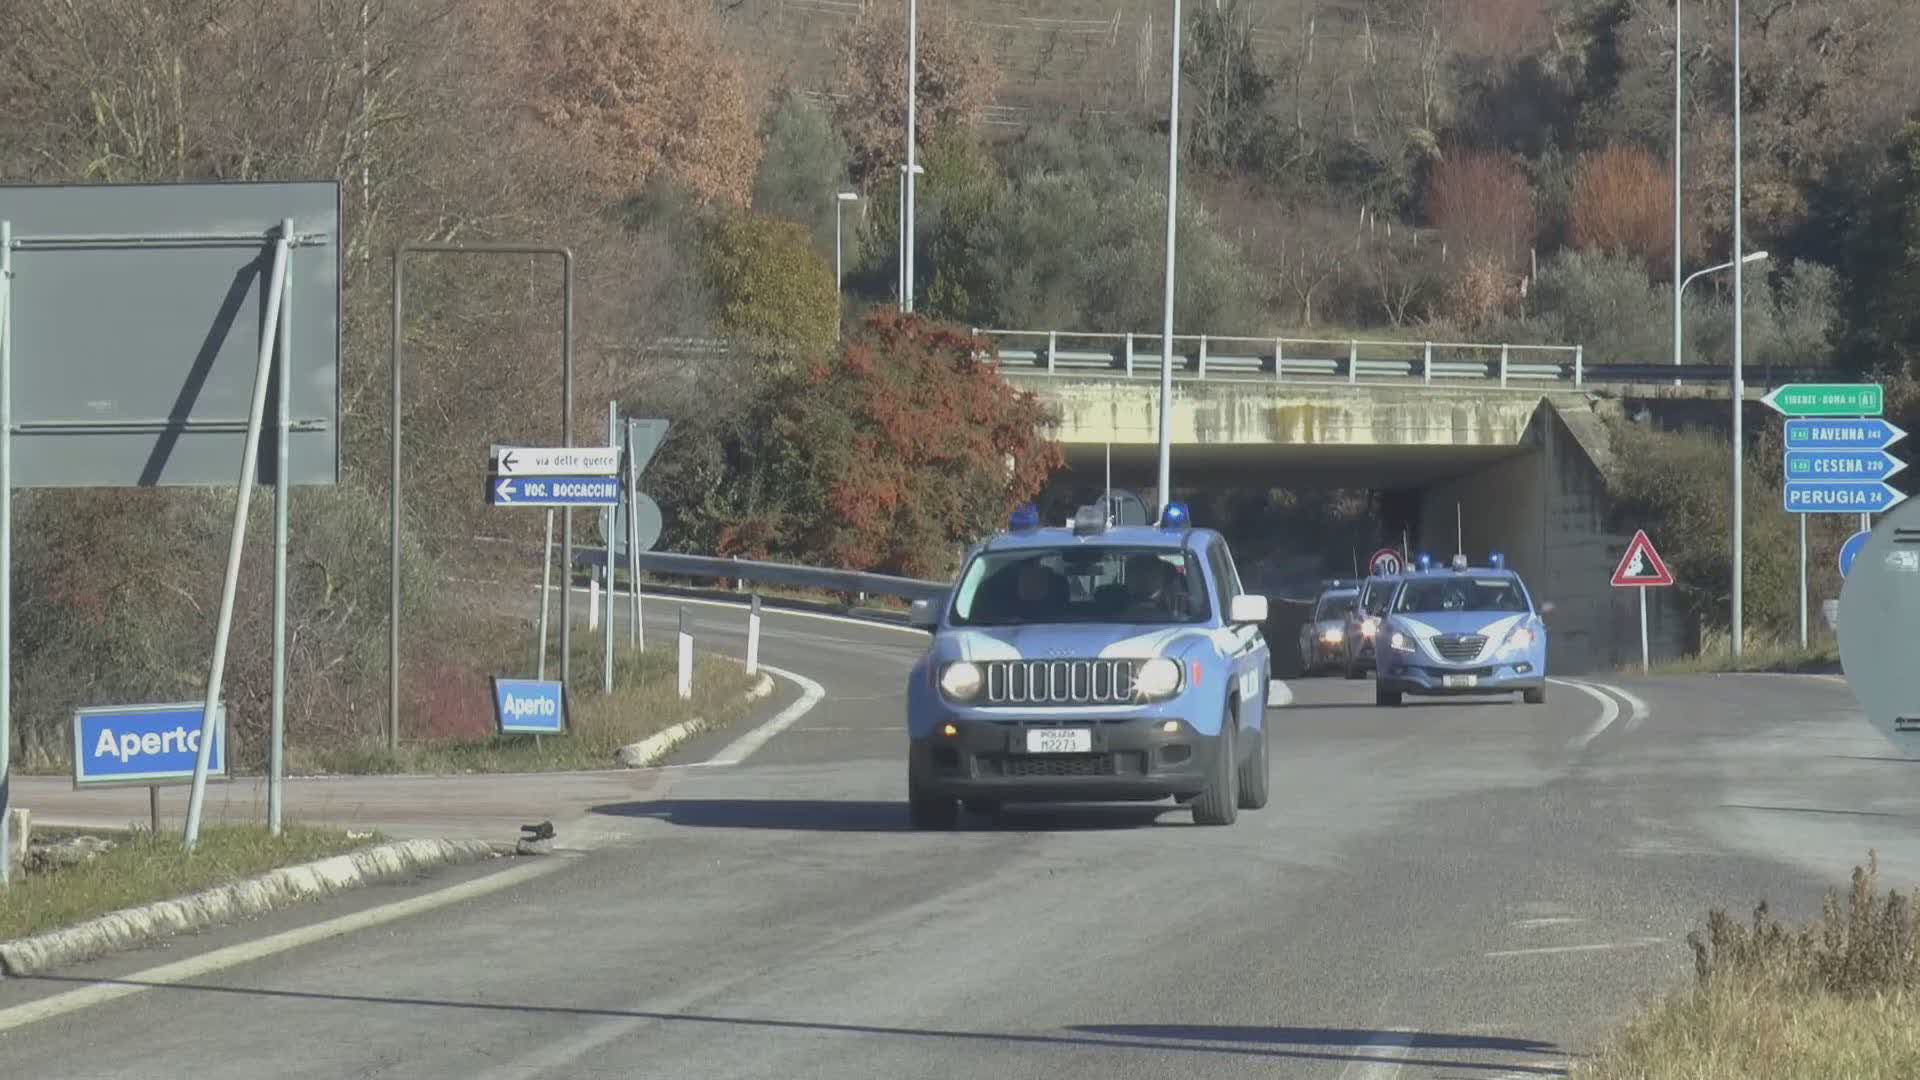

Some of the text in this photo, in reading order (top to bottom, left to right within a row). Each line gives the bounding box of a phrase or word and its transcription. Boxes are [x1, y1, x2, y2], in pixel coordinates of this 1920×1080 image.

[1812, 427, 1864, 440] RAVENNA
[535, 455, 614, 468] via delle querce
[1814, 459, 1863, 473] CESENA
[524, 483, 617, 497] VOC. BOCCACCINI
[1790, 490, 1866, 504] PERUGIA
[503, 692, 555, 720] Aperto
